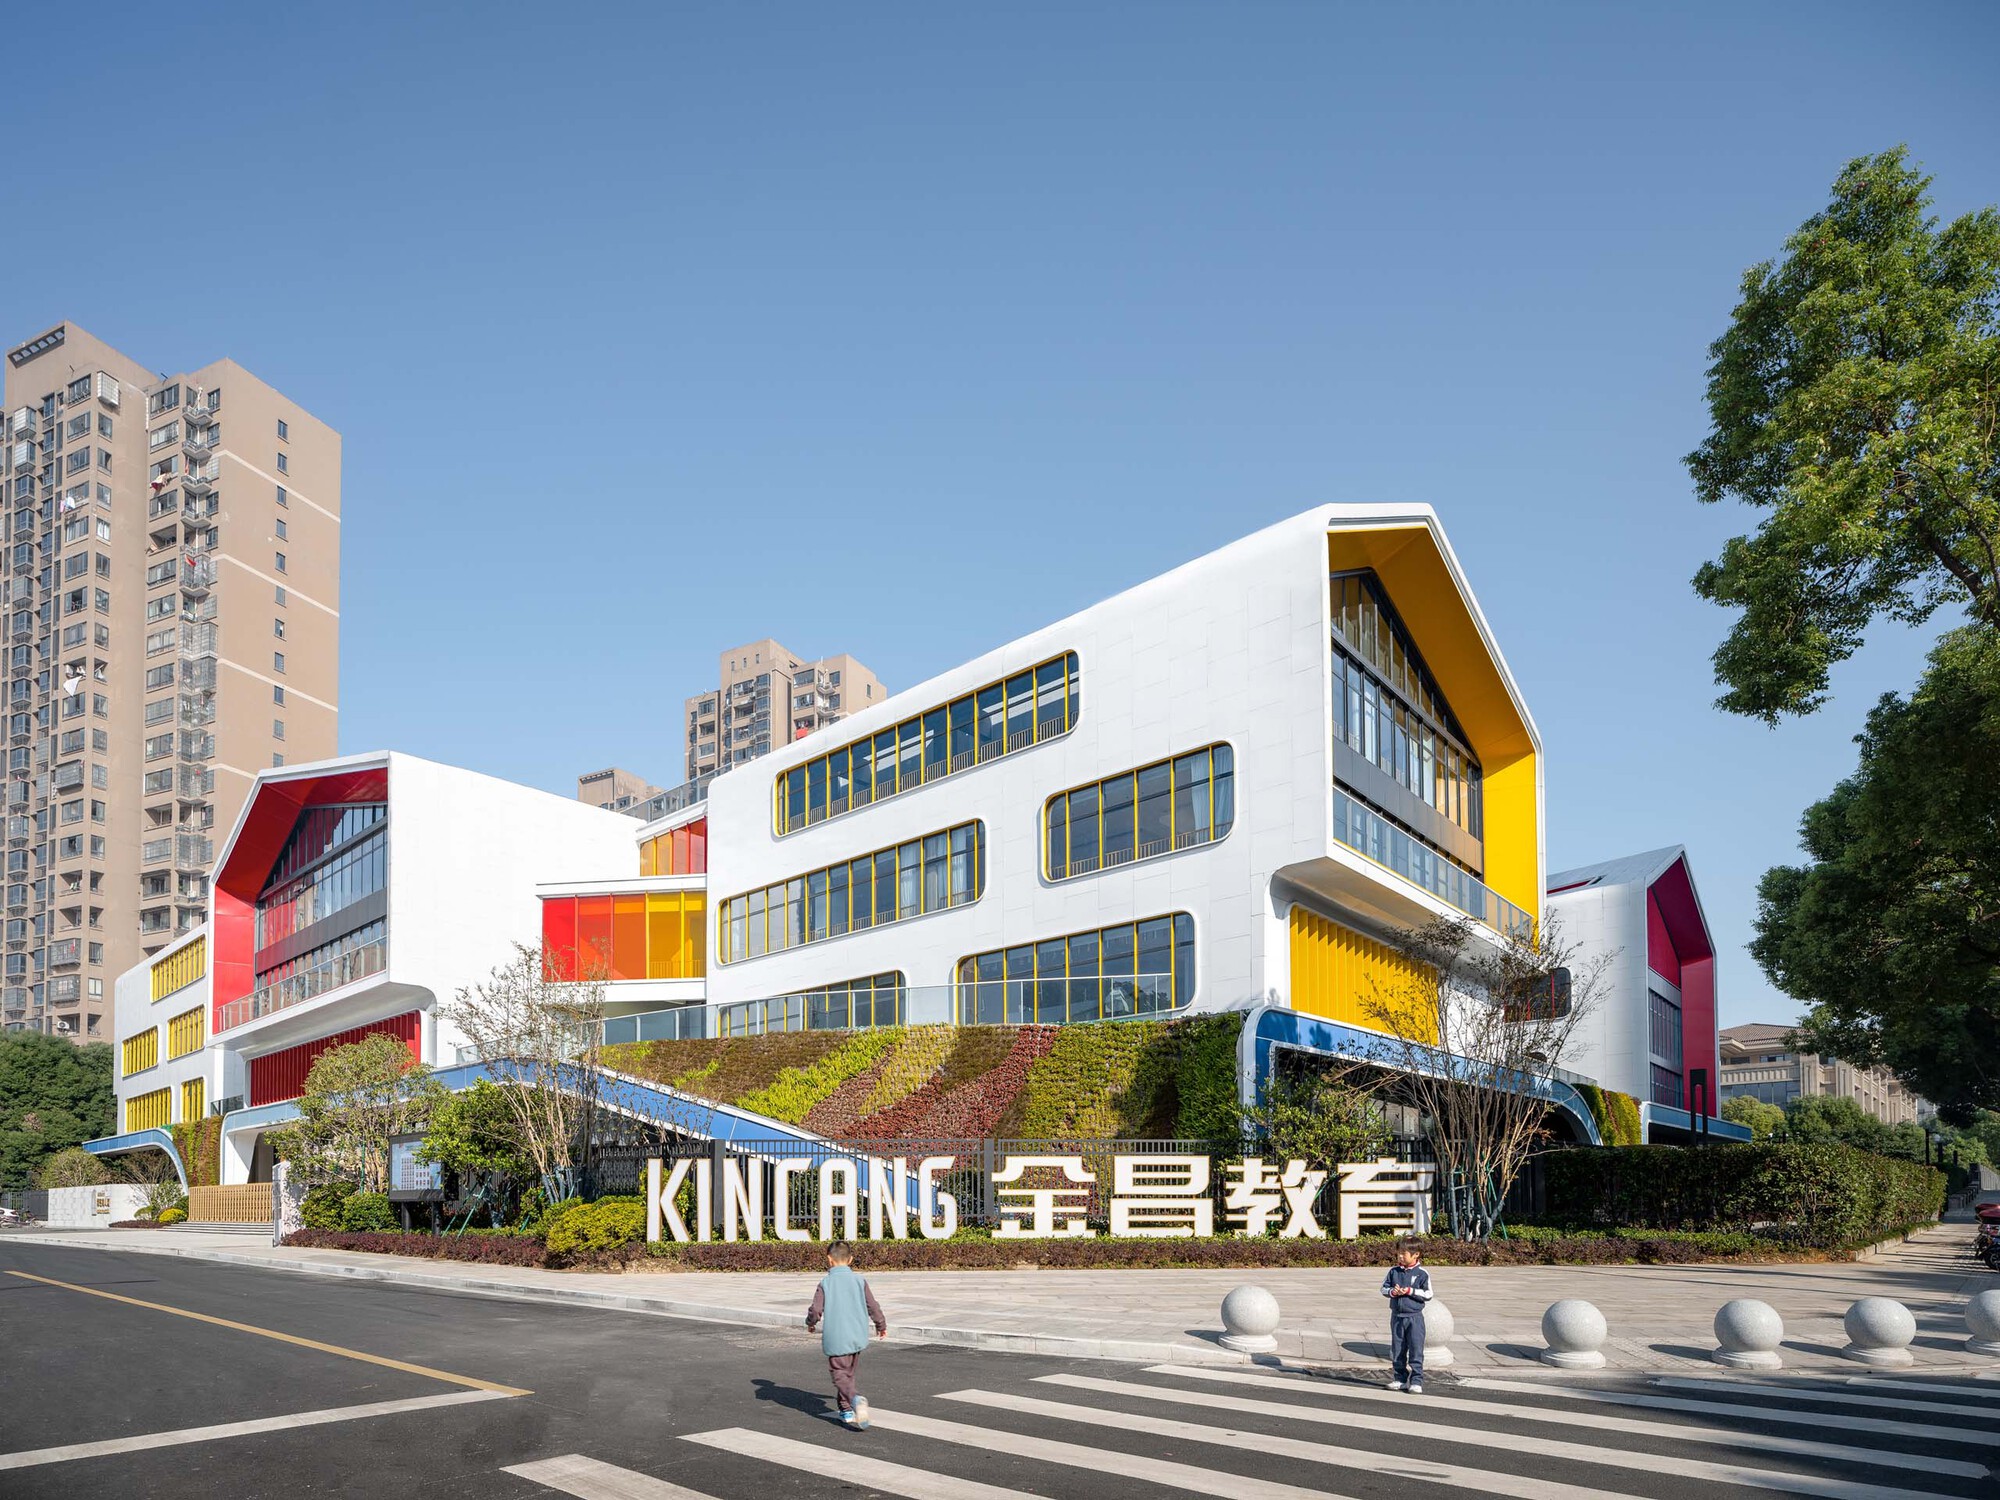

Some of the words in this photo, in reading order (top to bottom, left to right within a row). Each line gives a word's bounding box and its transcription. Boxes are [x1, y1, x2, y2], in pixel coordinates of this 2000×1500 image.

[646, 1156, 957, 1242] KINCANG
[991, 1156, 1436, 1239] 金昌教育
